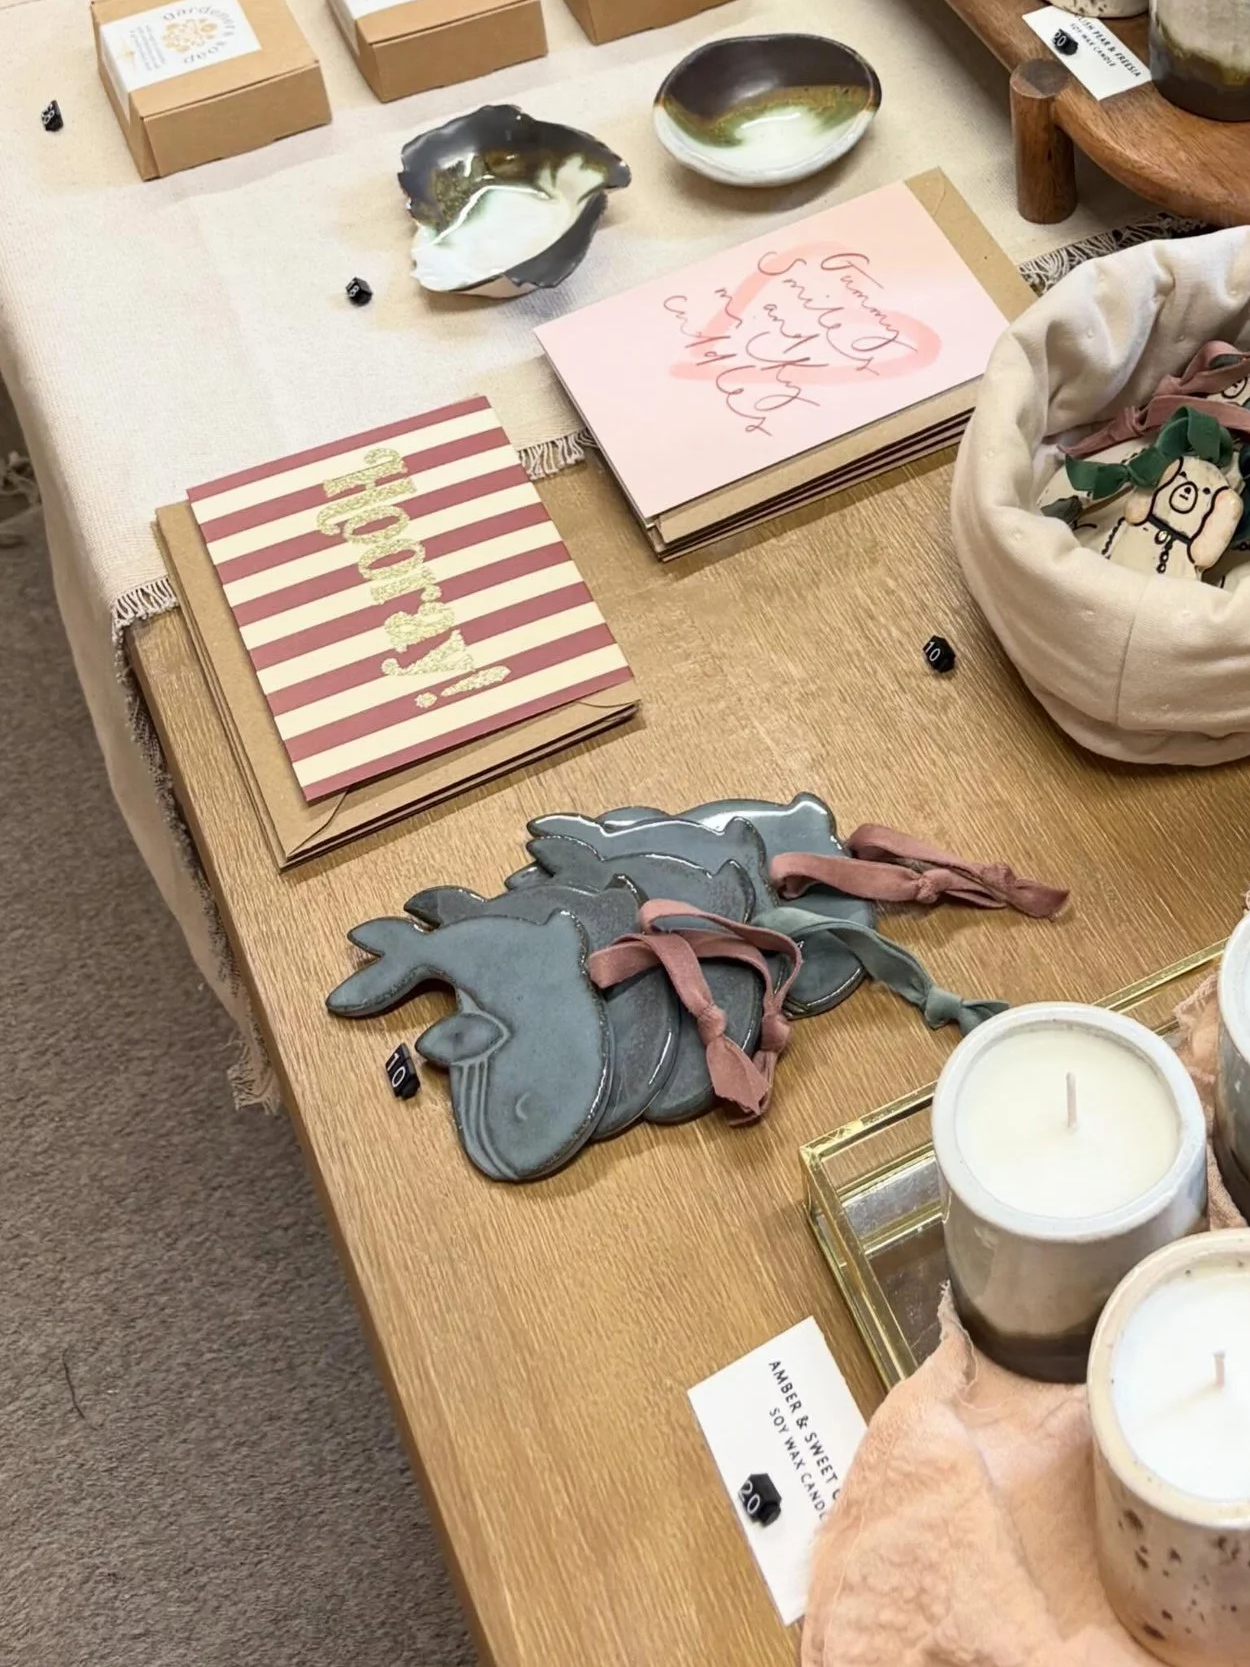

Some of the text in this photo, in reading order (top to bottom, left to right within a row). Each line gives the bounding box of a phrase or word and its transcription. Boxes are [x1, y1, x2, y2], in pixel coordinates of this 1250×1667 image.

[1092, 30, 1111, 46] PEAR
[1114, 51, 1141, 77] FREESIA
[1093, 45, 1116, 67] CANDLE
[763, 303, 819, 354] and
[925, 641, 941, 662] 10
[387, 1053, 406, 1087] 10
[767, 1360, 839, 1483] AMBER & SWEET
[769, 1407, 828, 1521] SOY WAX CANDL
[738, 1479, 760, 1516] 20
